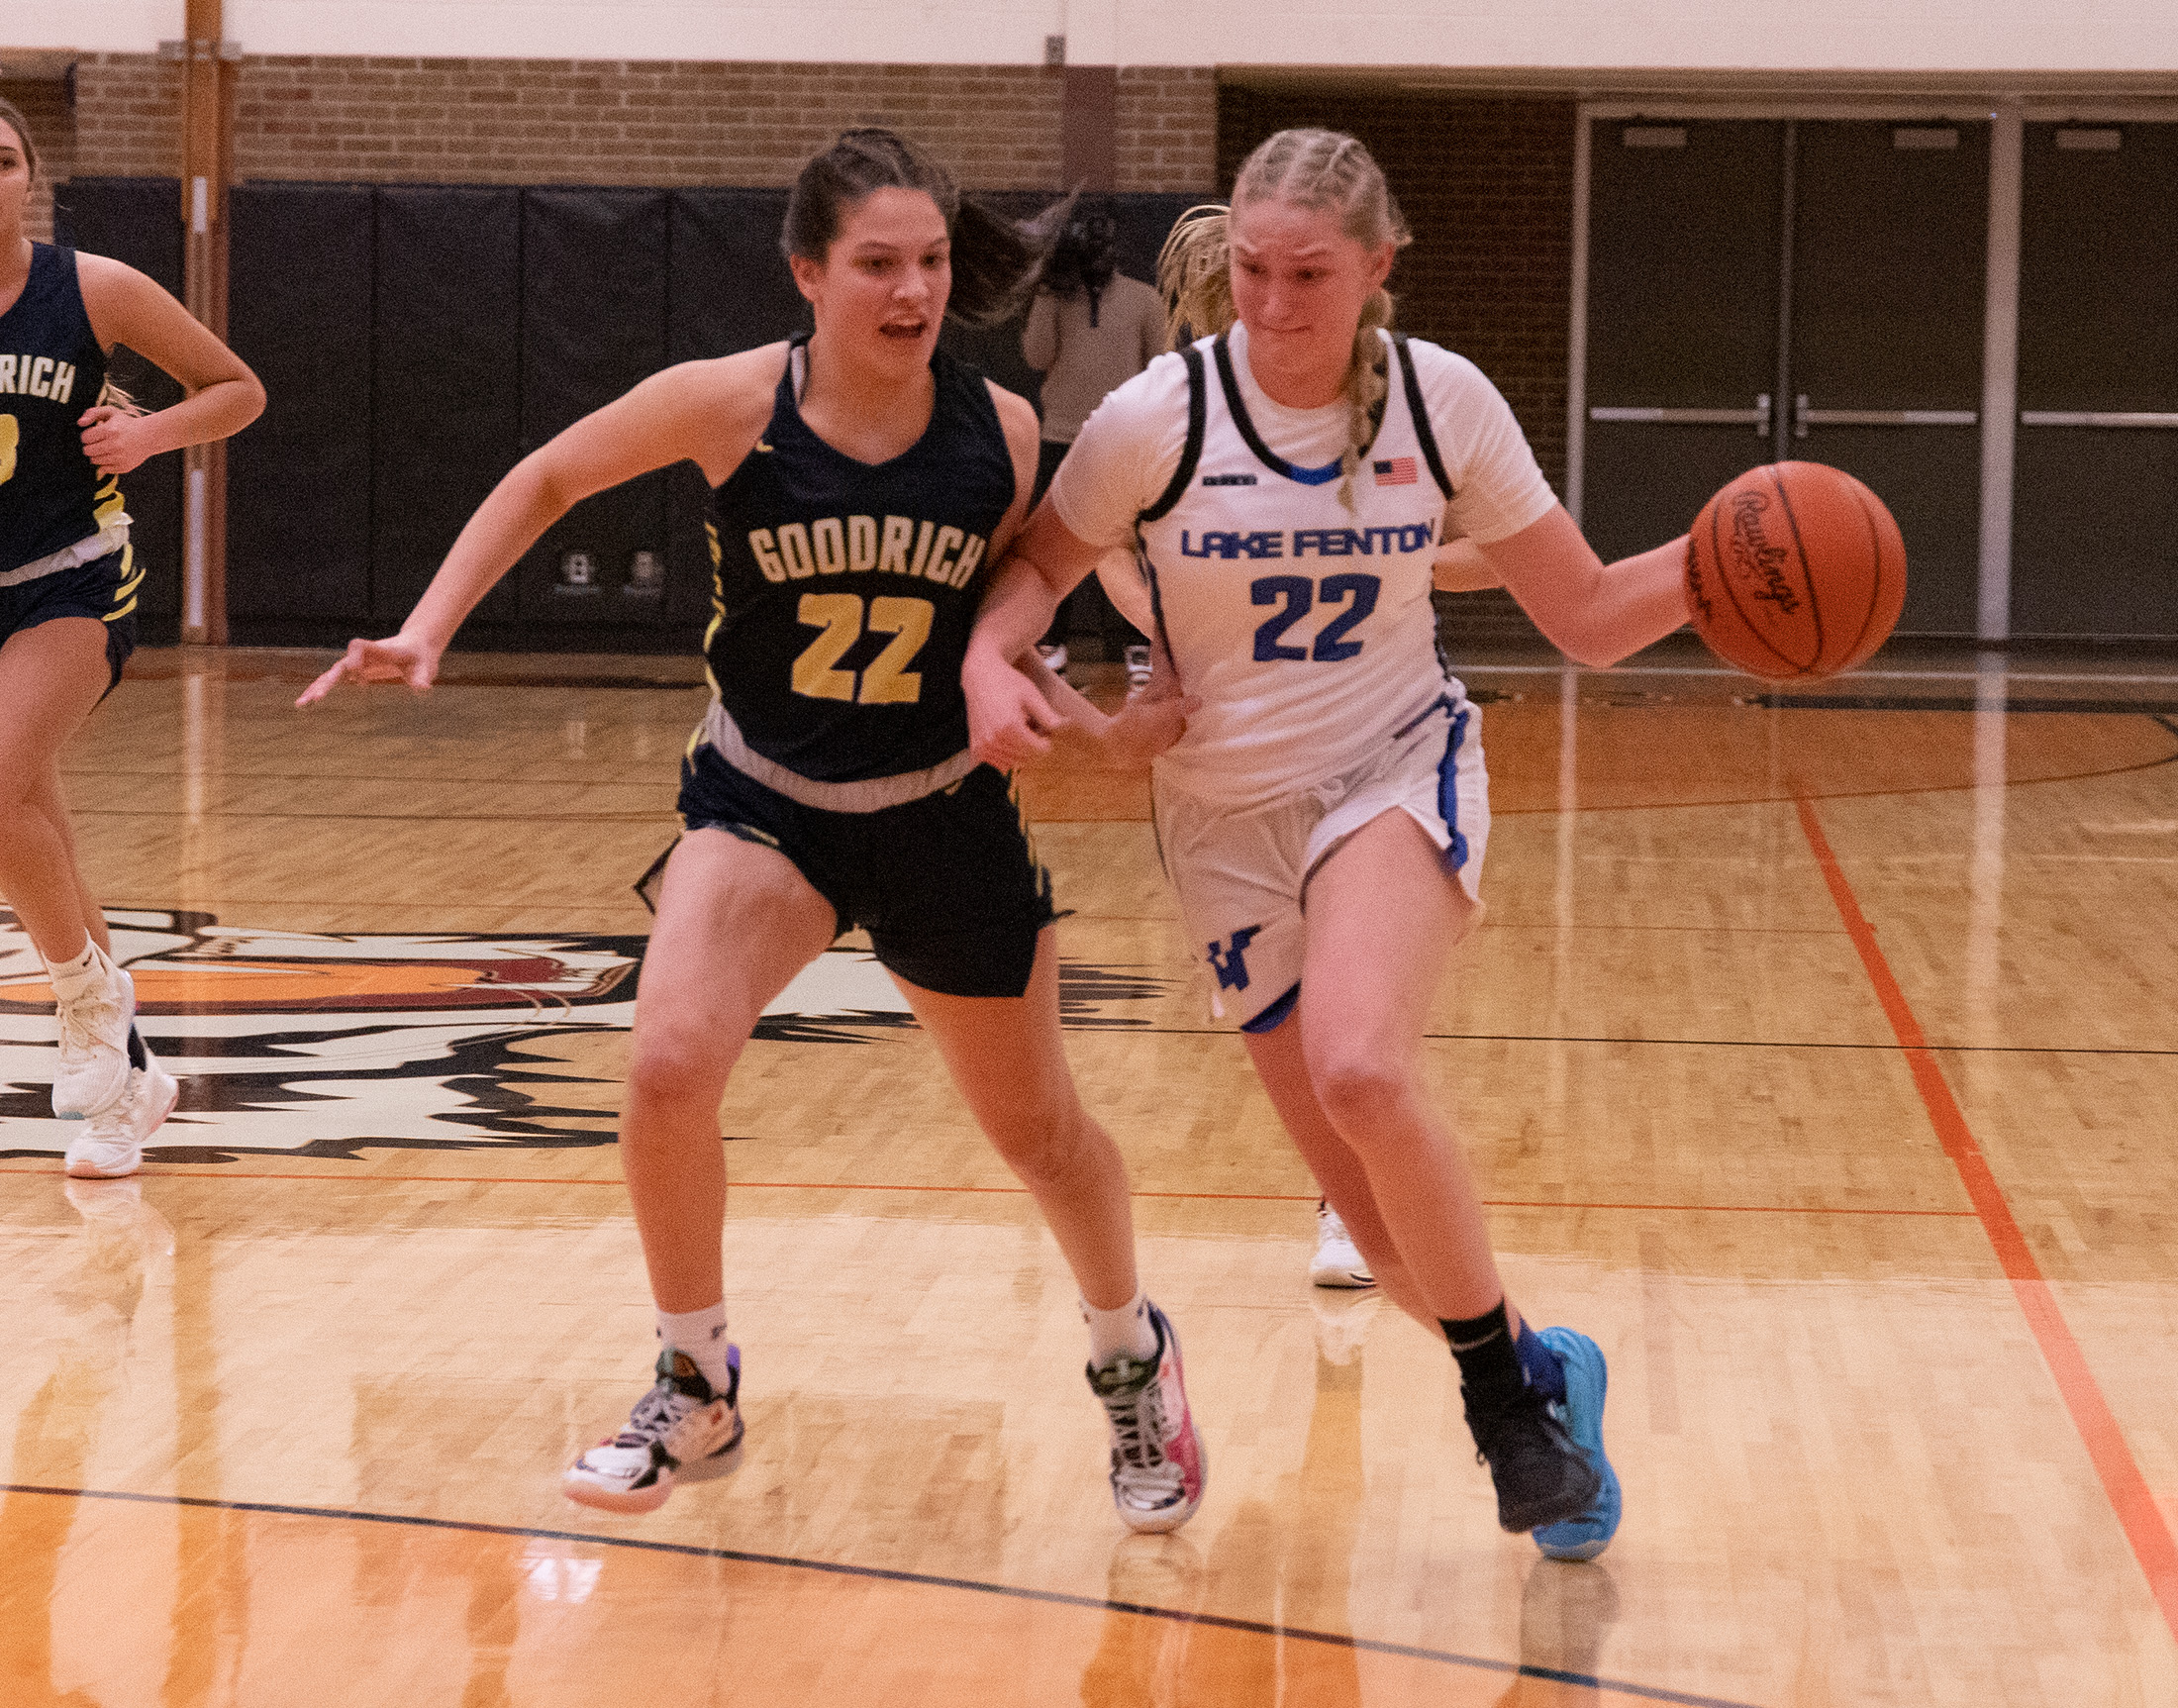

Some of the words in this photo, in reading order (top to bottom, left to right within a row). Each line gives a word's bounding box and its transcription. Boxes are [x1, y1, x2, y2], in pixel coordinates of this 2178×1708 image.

[0, 353, 76, 405] RICH
[748, 514, 987, 591] GOODRICH
[1181, 529, 1284, 559] LAKE
[1292, 517, 1436, 557] FENTON
[1732, 490, 1801, 615] Rawlings
[791, 592, 935, 705] 22
[1250, 572, 1382, 662] 22
